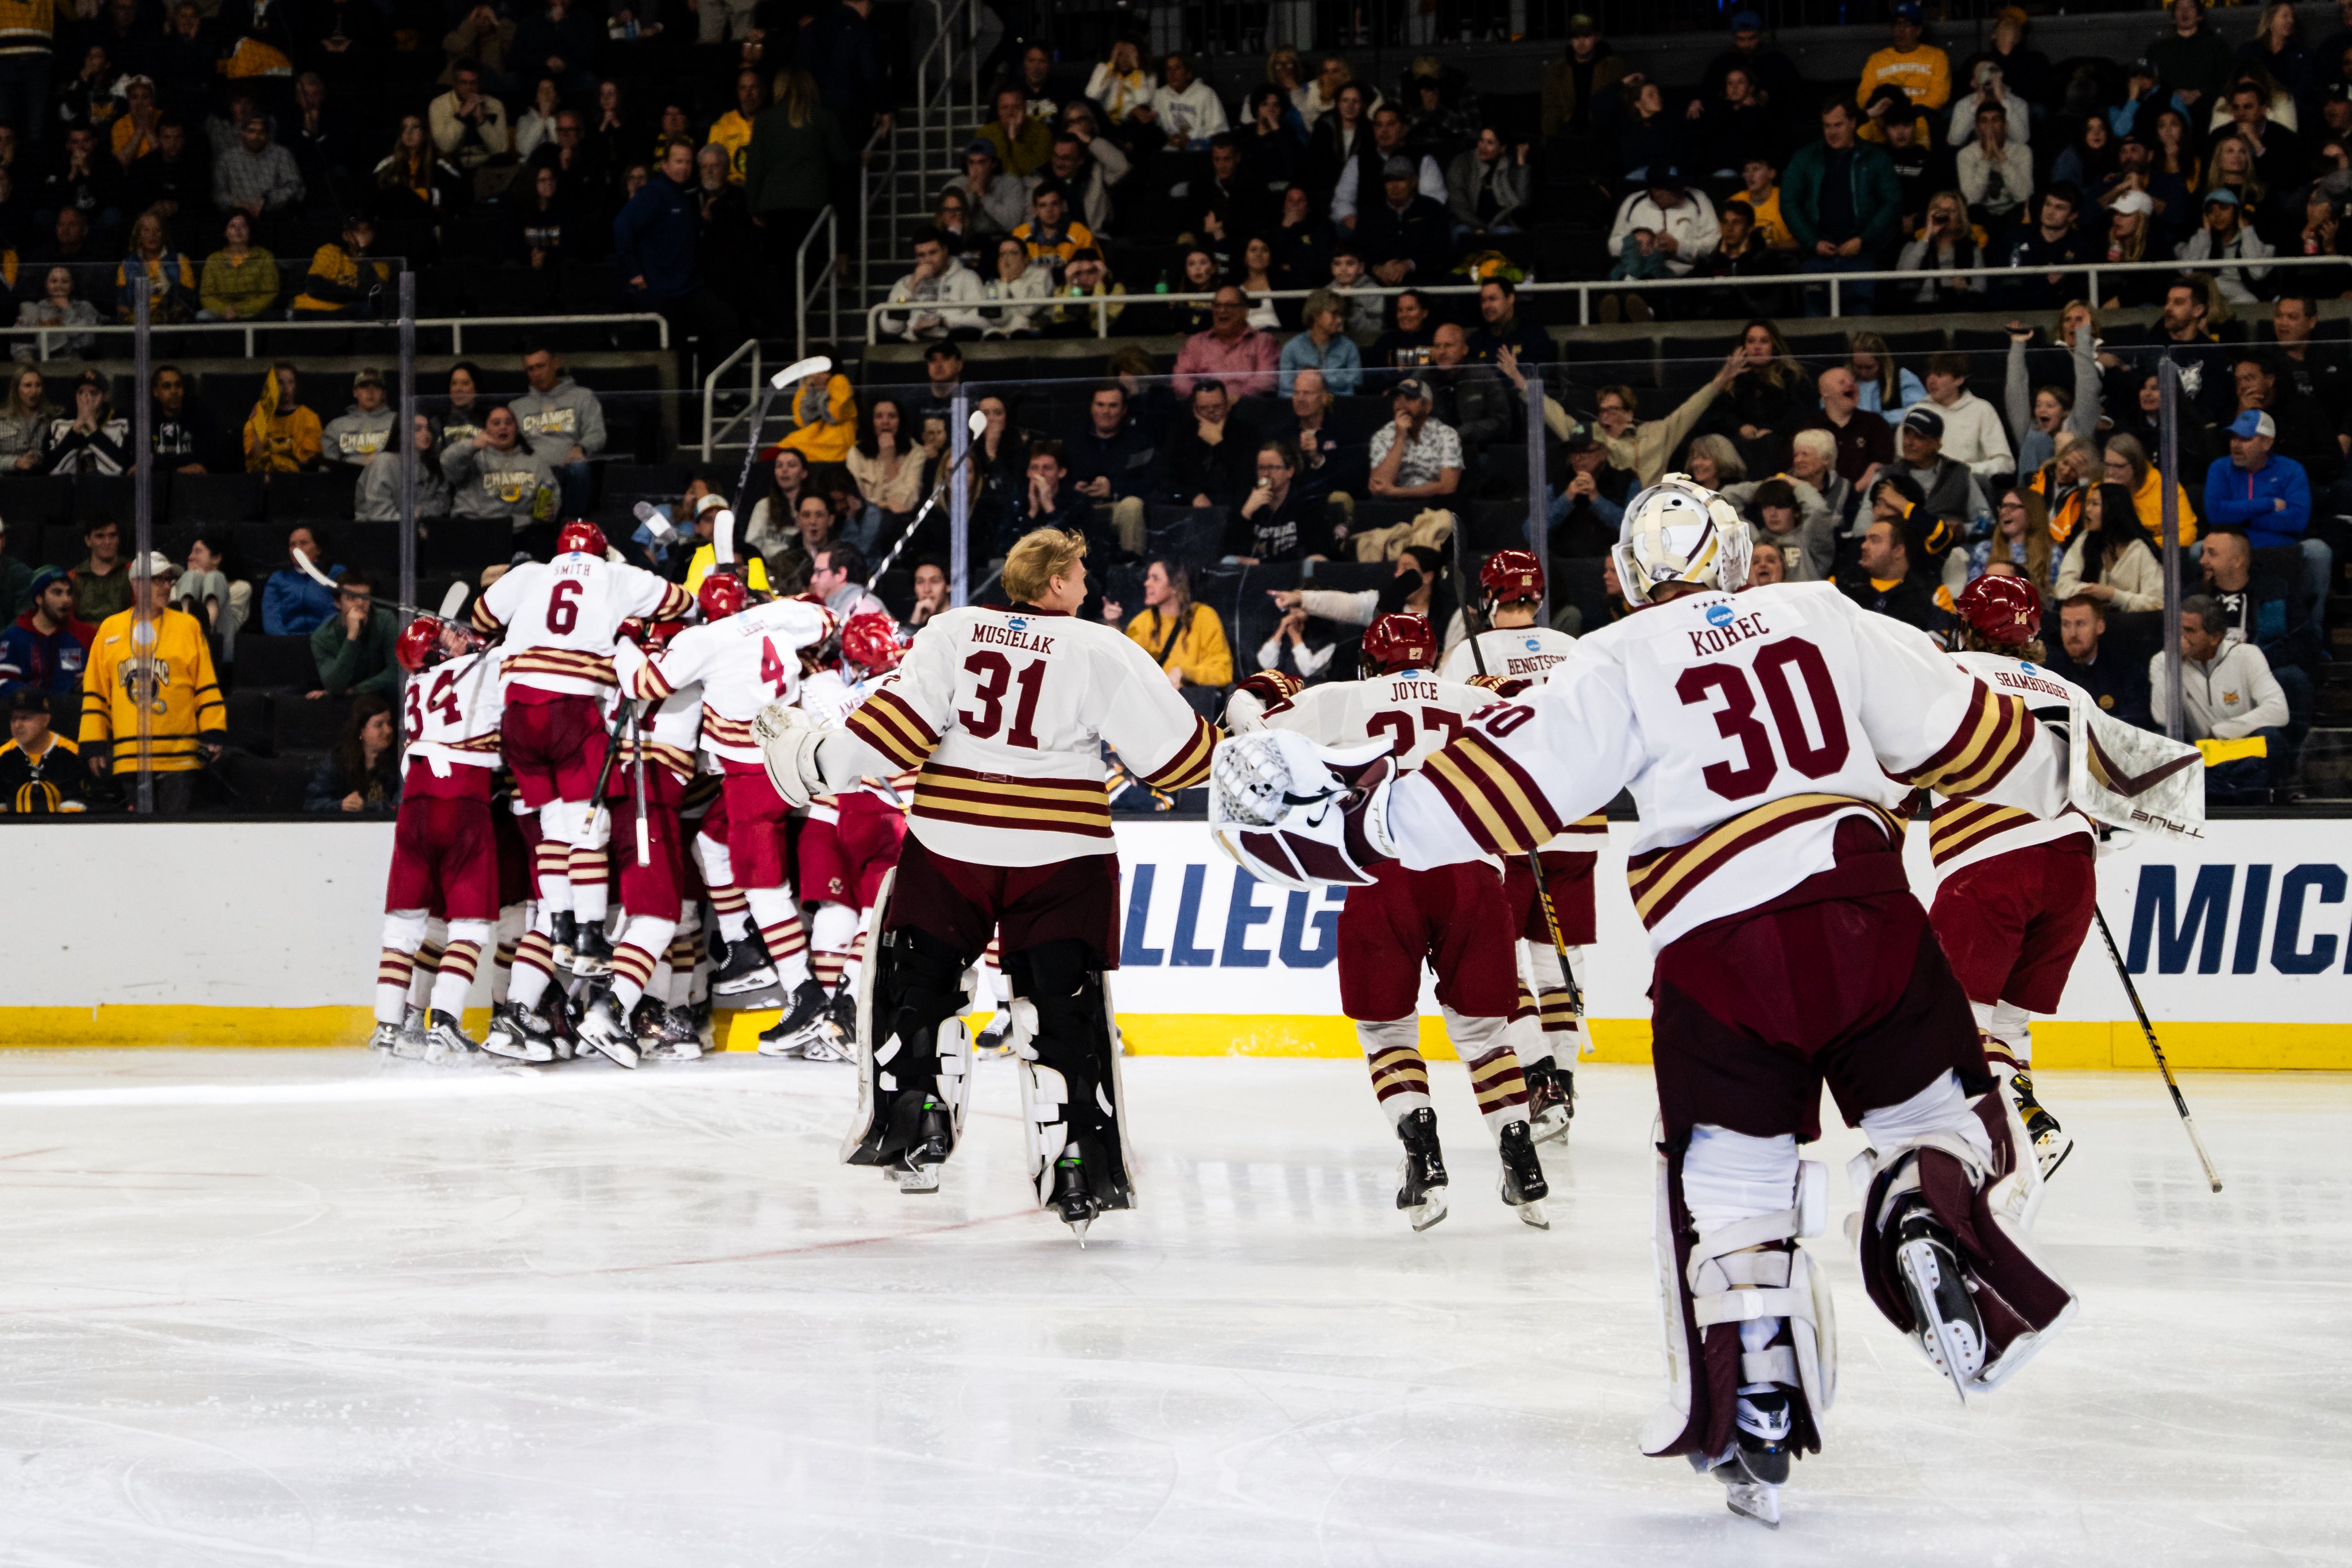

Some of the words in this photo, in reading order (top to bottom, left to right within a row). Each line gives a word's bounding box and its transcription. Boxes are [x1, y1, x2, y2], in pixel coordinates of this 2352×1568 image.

[483, 472, 535, 490] CHAMPS
[554, 563, 590, 576] SMITH
[546, 579, 583, 636] 6
[2014, 612, 2027, 625] 14
[971, 624, 1055, 655] MUSIELAK
[1409, 648, 1422, 660] 27
[1688, 612, 1770, 657] KOREC
[760, 636, 787, 699] 4
[1995, 672, 2070, 700] SHAMBURGER
[405, 670, 463, 741] 34
[957, 650, 1047, 750] 31
[1391, 682, 1438, 702] JOYCE
[1366, 706, 1463, 757] 27
[1674, 636, 1850, 802] 30
[1373, 801, 1395, 856] TRUE
[2131, 809, 2204, 839] TRUE
[2126, 864, 2352, 975] MIC
[1663, 1252, 1678, 1384] TRUE
